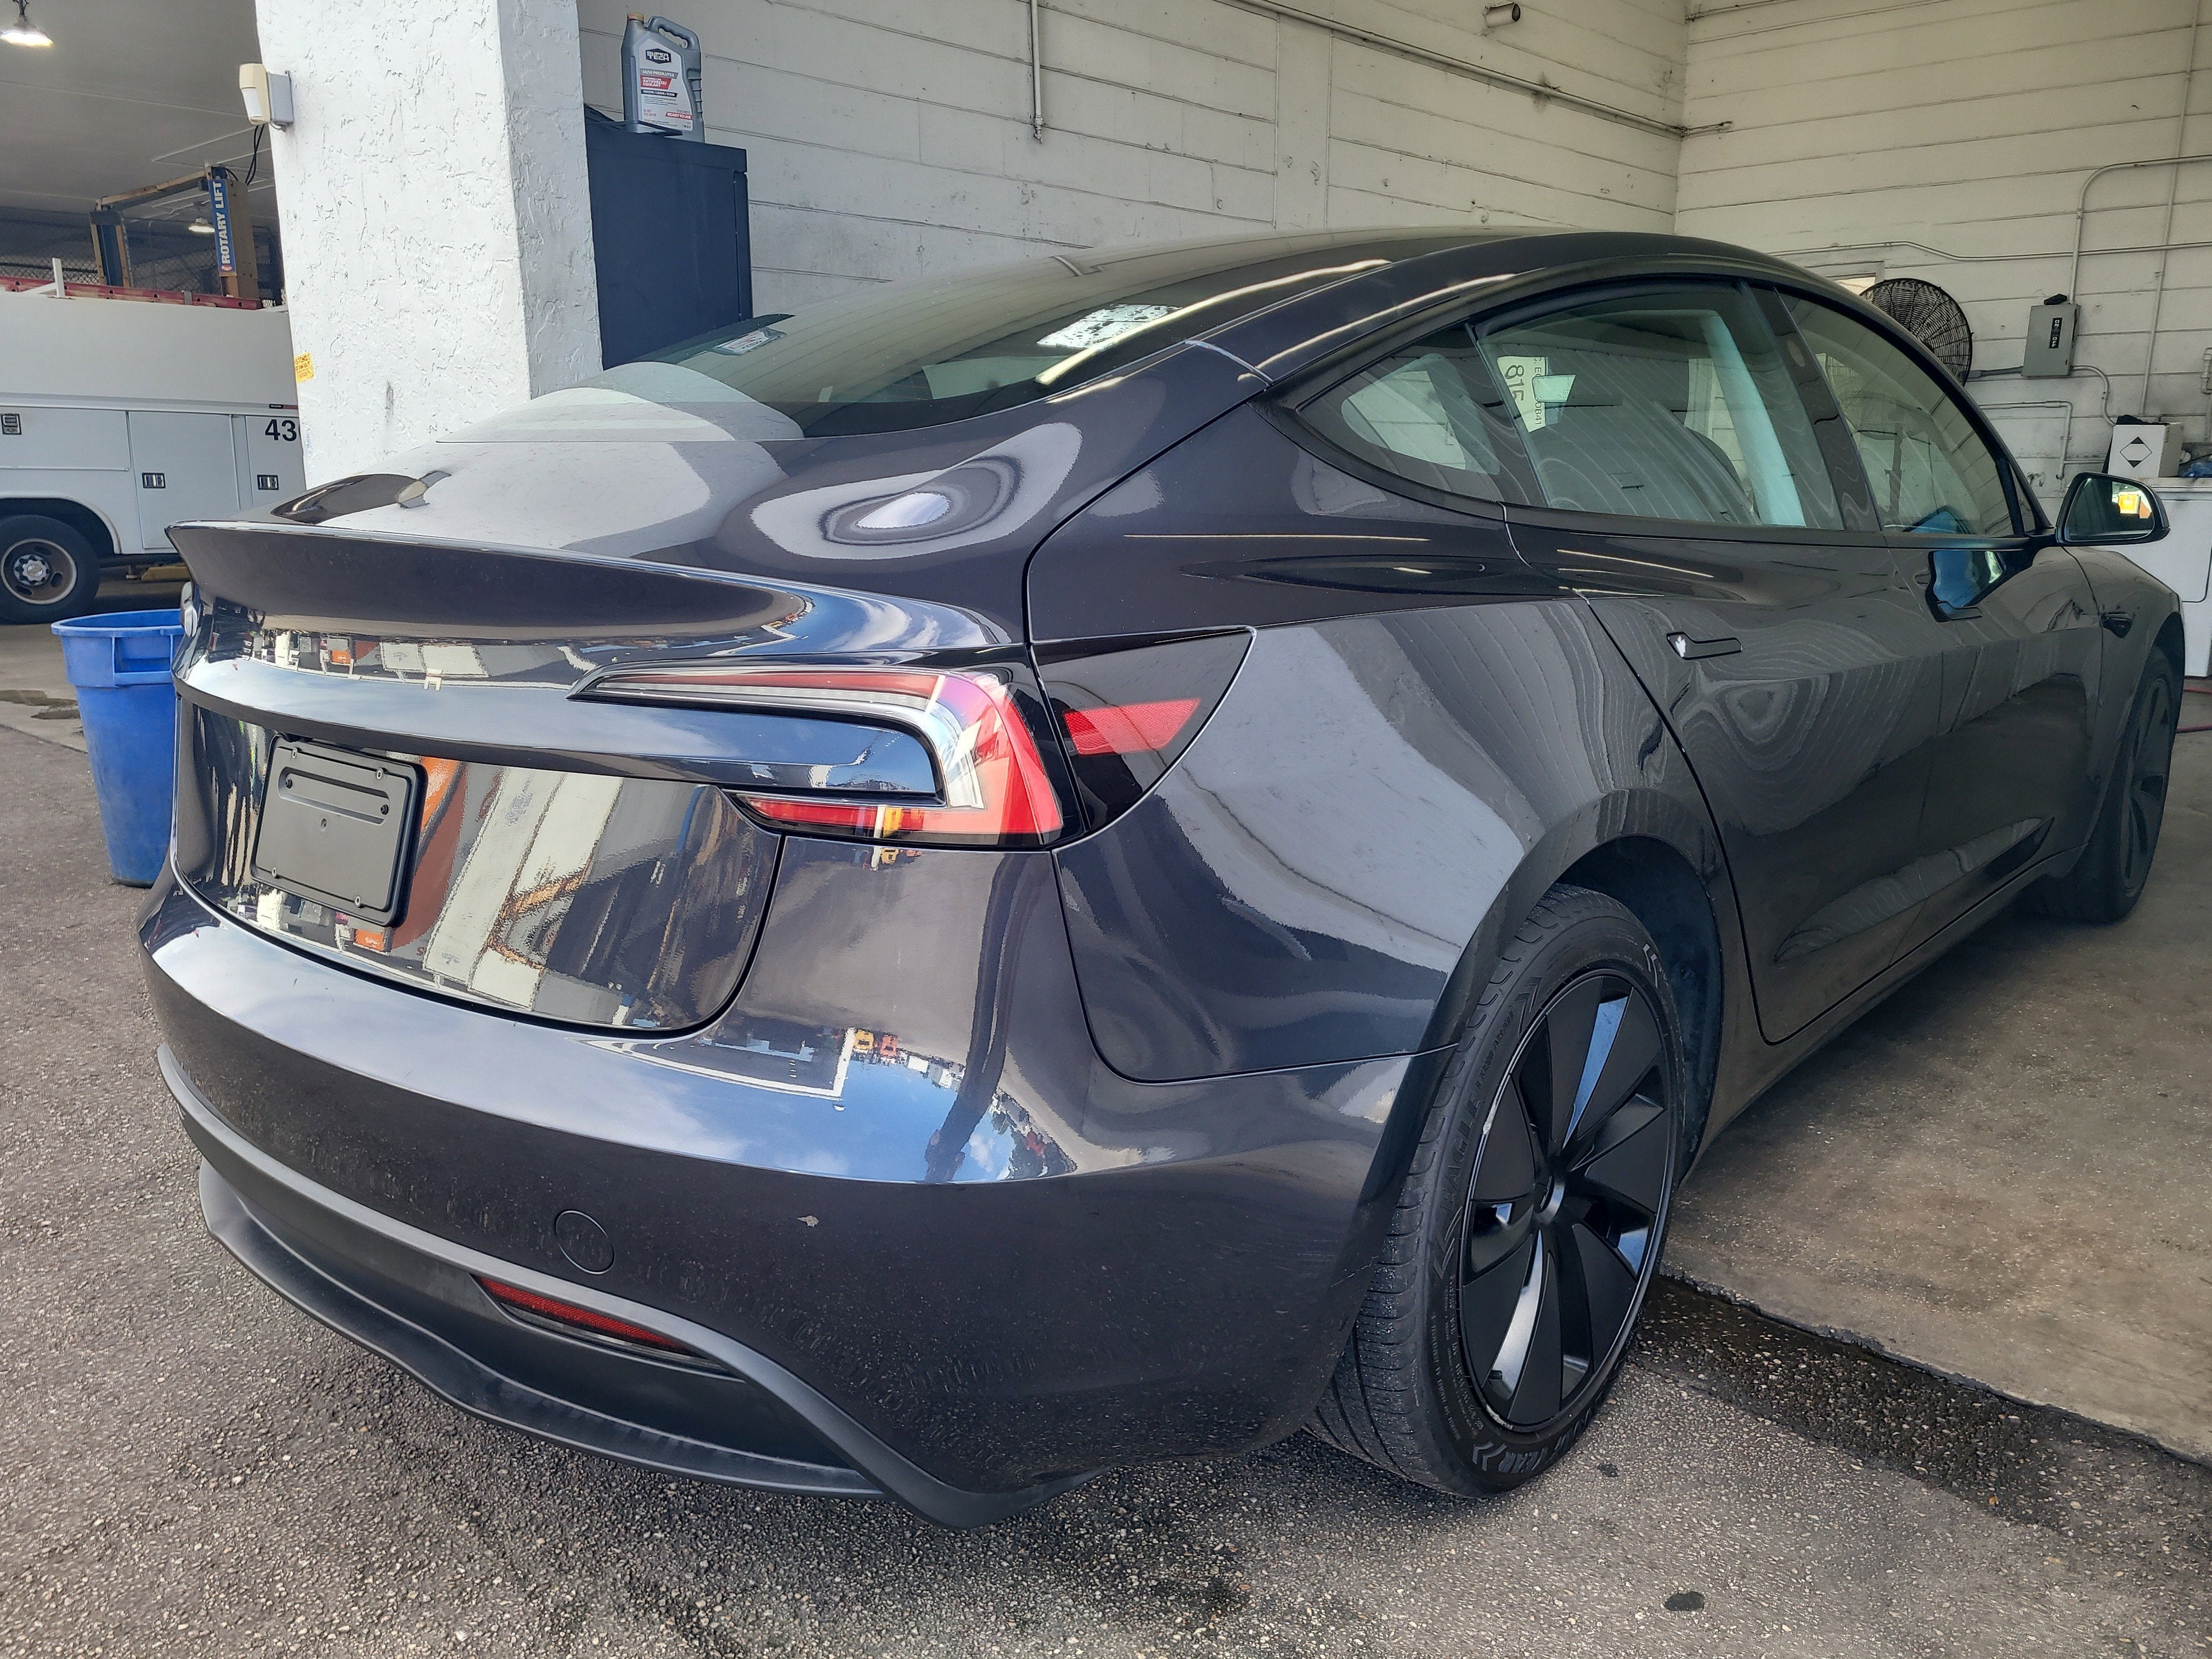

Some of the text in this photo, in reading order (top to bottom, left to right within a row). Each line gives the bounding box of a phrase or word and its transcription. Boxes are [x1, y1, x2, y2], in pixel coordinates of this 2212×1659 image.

[213, 181, 230, 264] ROTARY LIFT
[265, 419, 301, 442] 43
[1440, 1095, 1480, 1211] EAGLE
